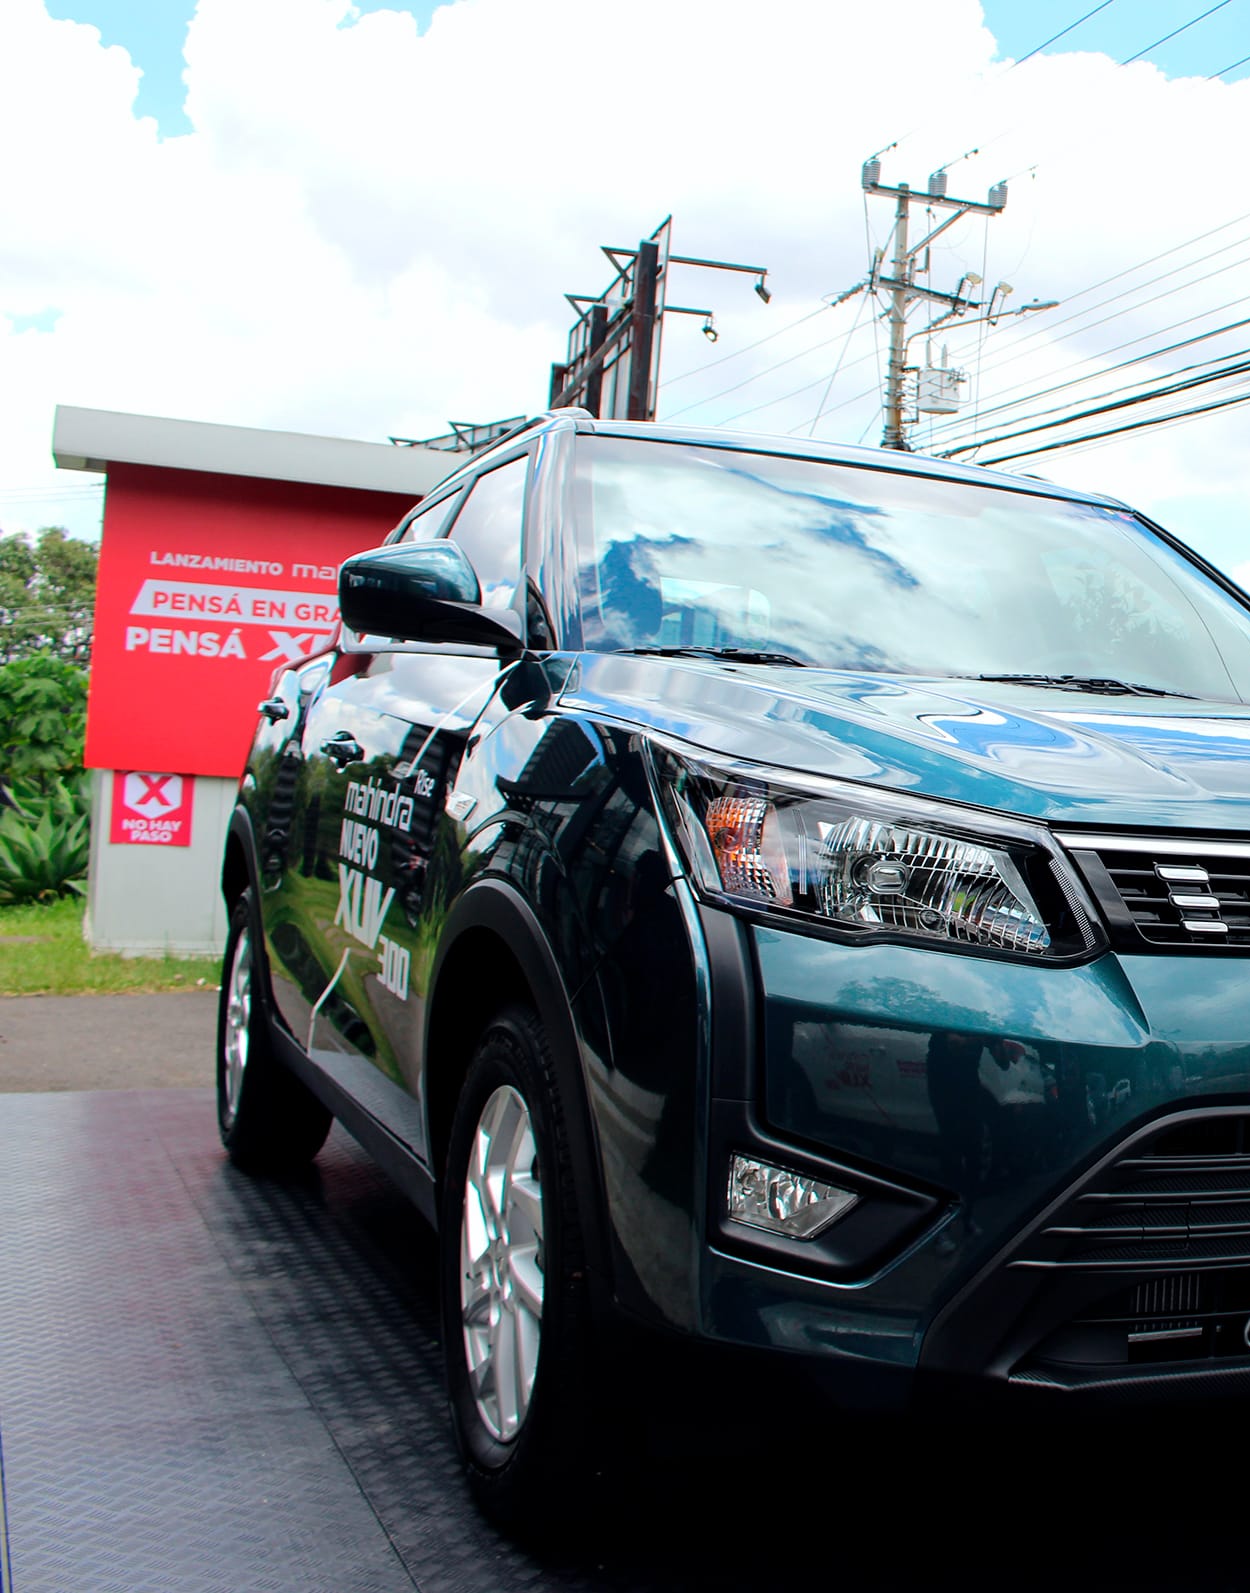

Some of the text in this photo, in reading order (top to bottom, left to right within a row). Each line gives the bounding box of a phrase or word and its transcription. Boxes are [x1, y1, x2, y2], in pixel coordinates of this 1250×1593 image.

[150, 551, 339, 580] LANZAMIENTO ma
[153, 591, 342, 622] PENSÁ EN GRA
[125, 626, 247, 659] PENSÁ
[344, 775, 415, 833] mahindra
[122, 819, 182, 832] NO HAY
[131, 831, 173, 843] PASO
[338, 818, 380, 871] NUEVO
[334, 862, 396, 950] XUV
[376, 934, 411, 1001] 300
